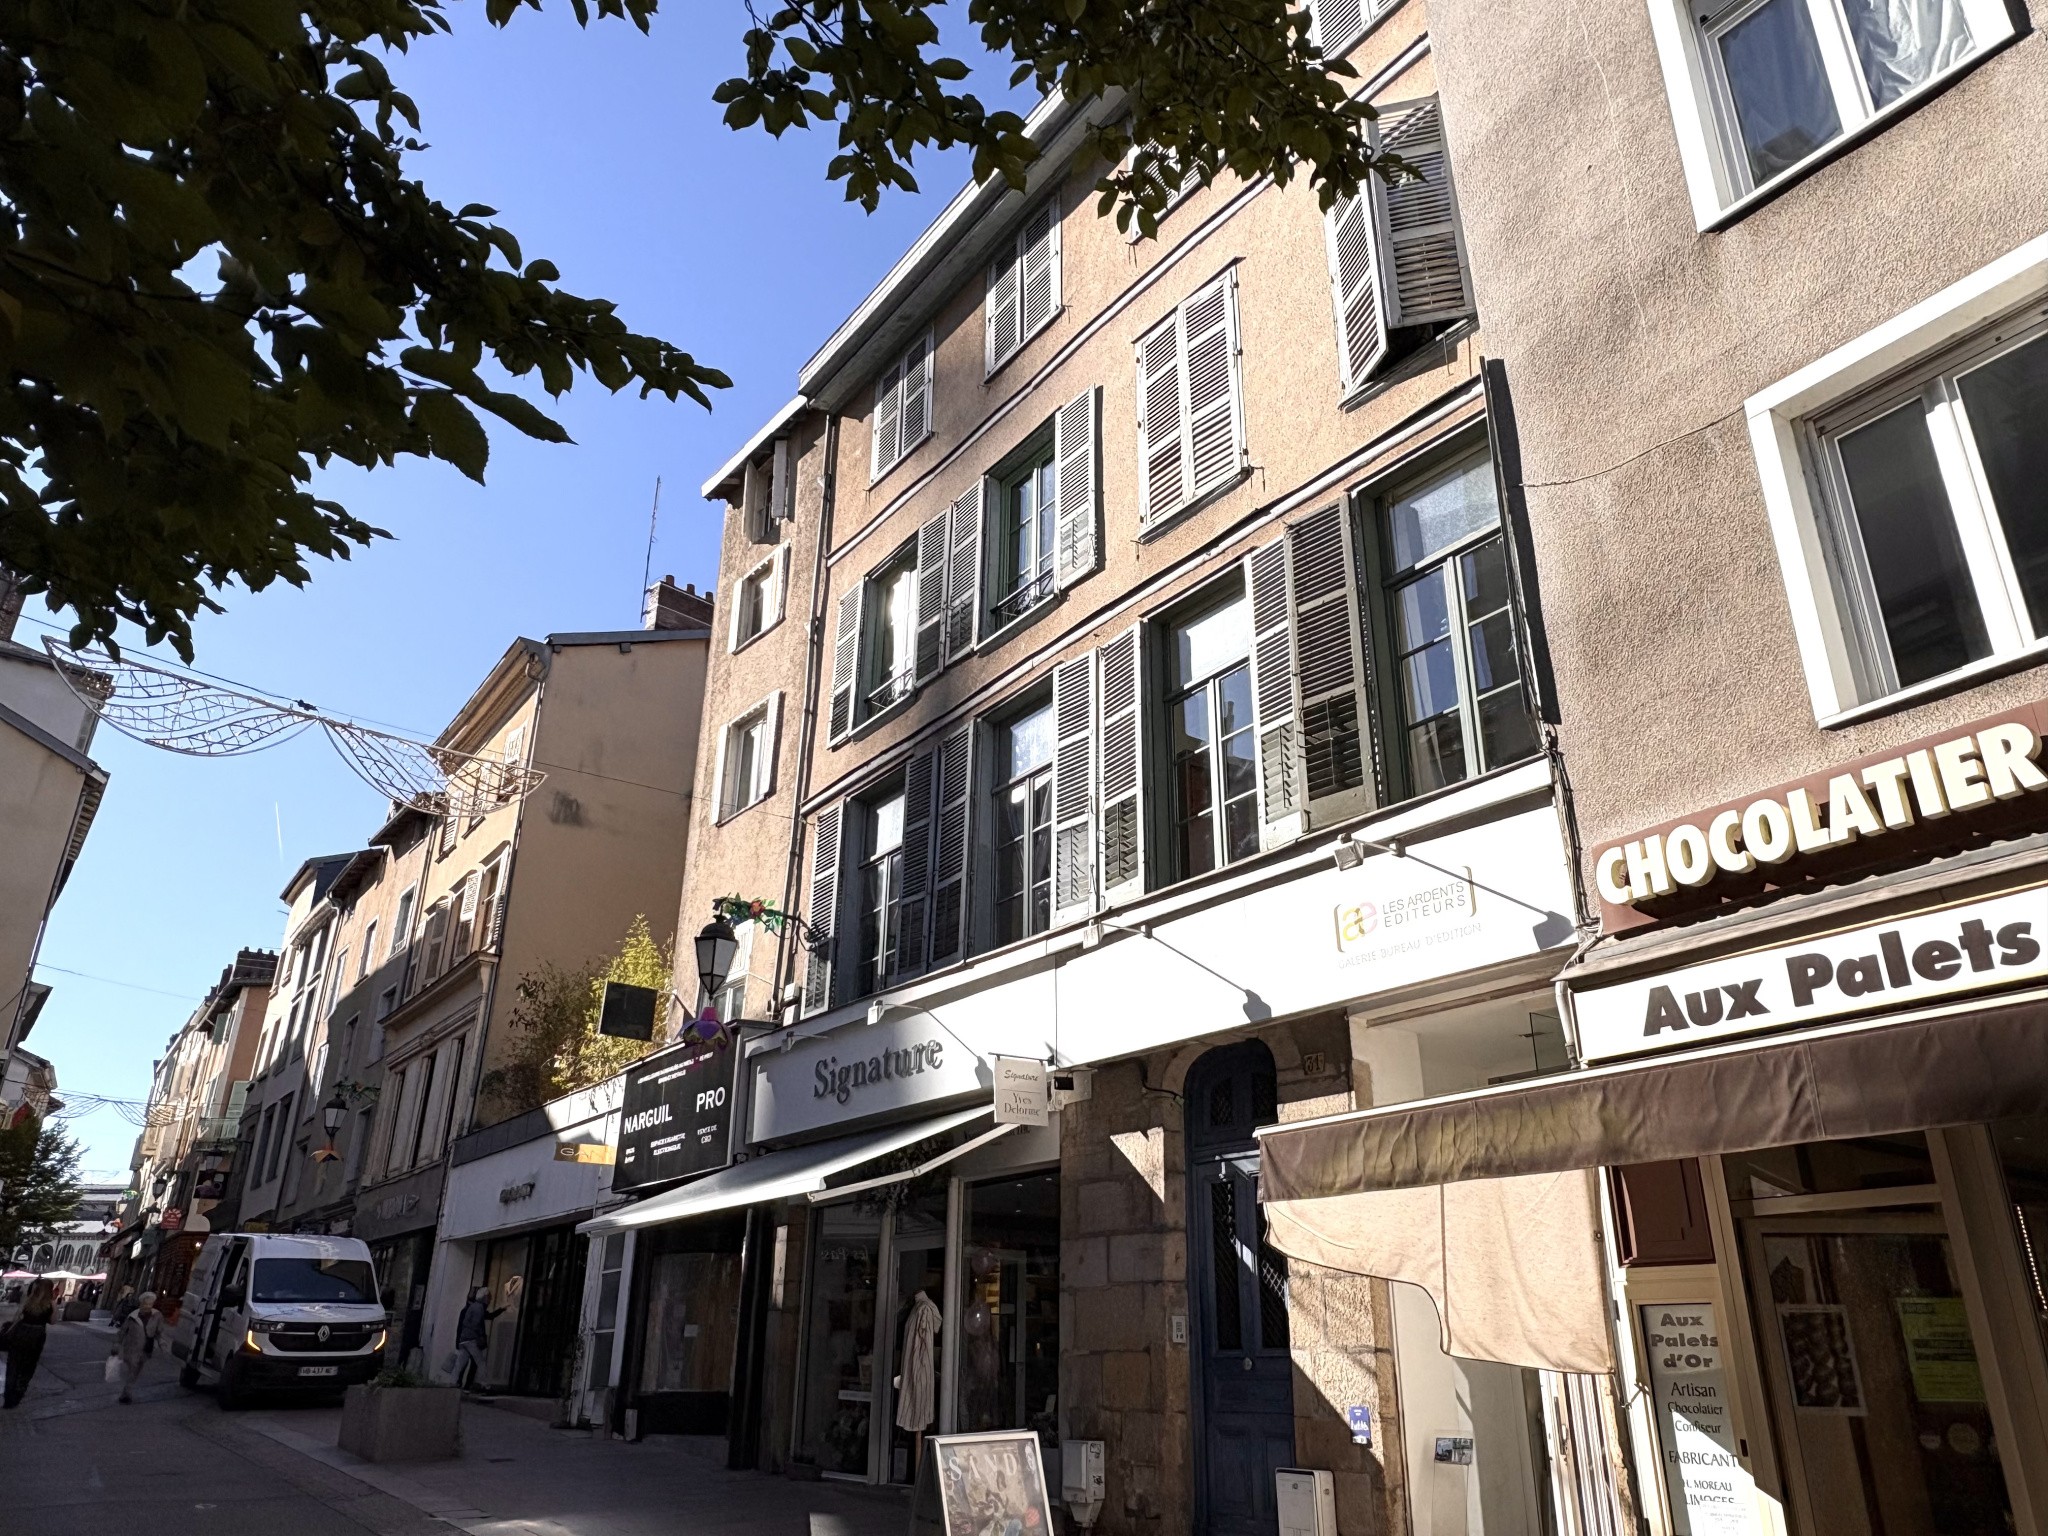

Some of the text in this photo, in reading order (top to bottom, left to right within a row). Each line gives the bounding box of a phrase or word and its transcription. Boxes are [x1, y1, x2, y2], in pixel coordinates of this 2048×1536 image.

[1596, 722, 2048, 907] CHOCOLATIER
[1382, 881, 1465, 915] LES ARDENTS
[1384, 894, 1467, 928] EDITEURS
[1338, 951, 1377, 969] GALERIE
[1380, 940, 1421, 959] BUREAU
[1643, 918, 2041, 1037] Aux Palets
[813, 1039, 944, 1105] Signature
[1003, 1069, 1040, 1082] Signature
[1012, 1092, 1033, 1105] Yves
[623, 1086, 726, 1134] NARGUIL PRO
[1003, 1102, 1041, 1117] Delorme
[1661, 1313, 1704, 1327] Aux
[1650, 1333, 1719, 1348] Palets
[1663, 1353, 1713, 1368] d'Or
[1671, 1382, 1717, 1398] Artisan
[1667, 1401, 1723, 1416] Chocolatier
[1674, 1420, 1722, 1434] Confiseur
[1693, 1479, 1733, 1492] MOREAU
